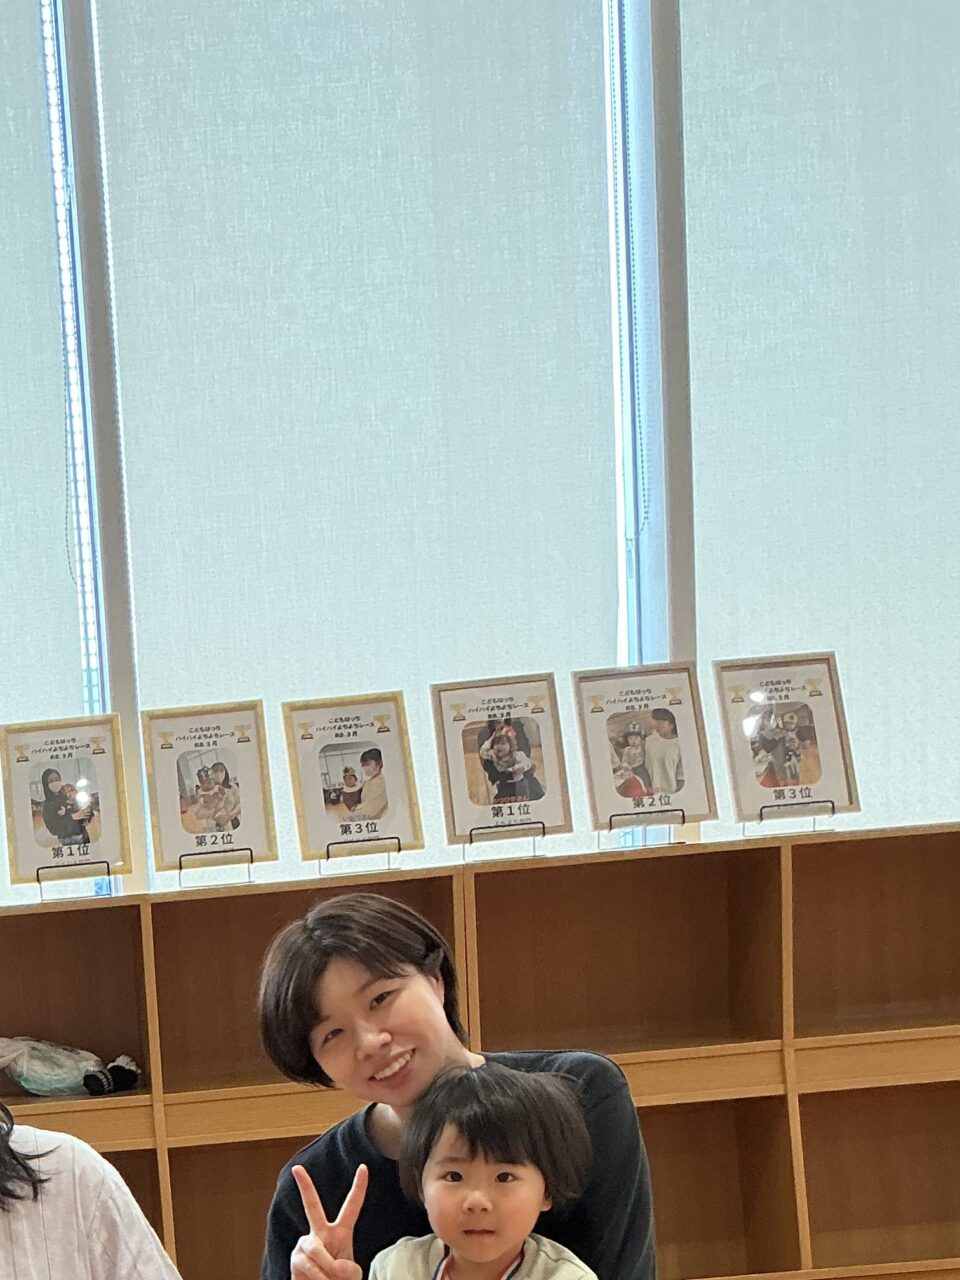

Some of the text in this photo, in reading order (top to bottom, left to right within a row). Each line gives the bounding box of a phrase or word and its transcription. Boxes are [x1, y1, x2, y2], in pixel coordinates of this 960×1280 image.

[773, 787, 813, 800] 第3位
[632, 795, 671, 809] 第2位
[491, 804, 531, 818] 第1位
[339, 821, 378, 835] 第3位
[195, 833, 234, 847] 第2位
[51, 844, 90, 859] 第1位
